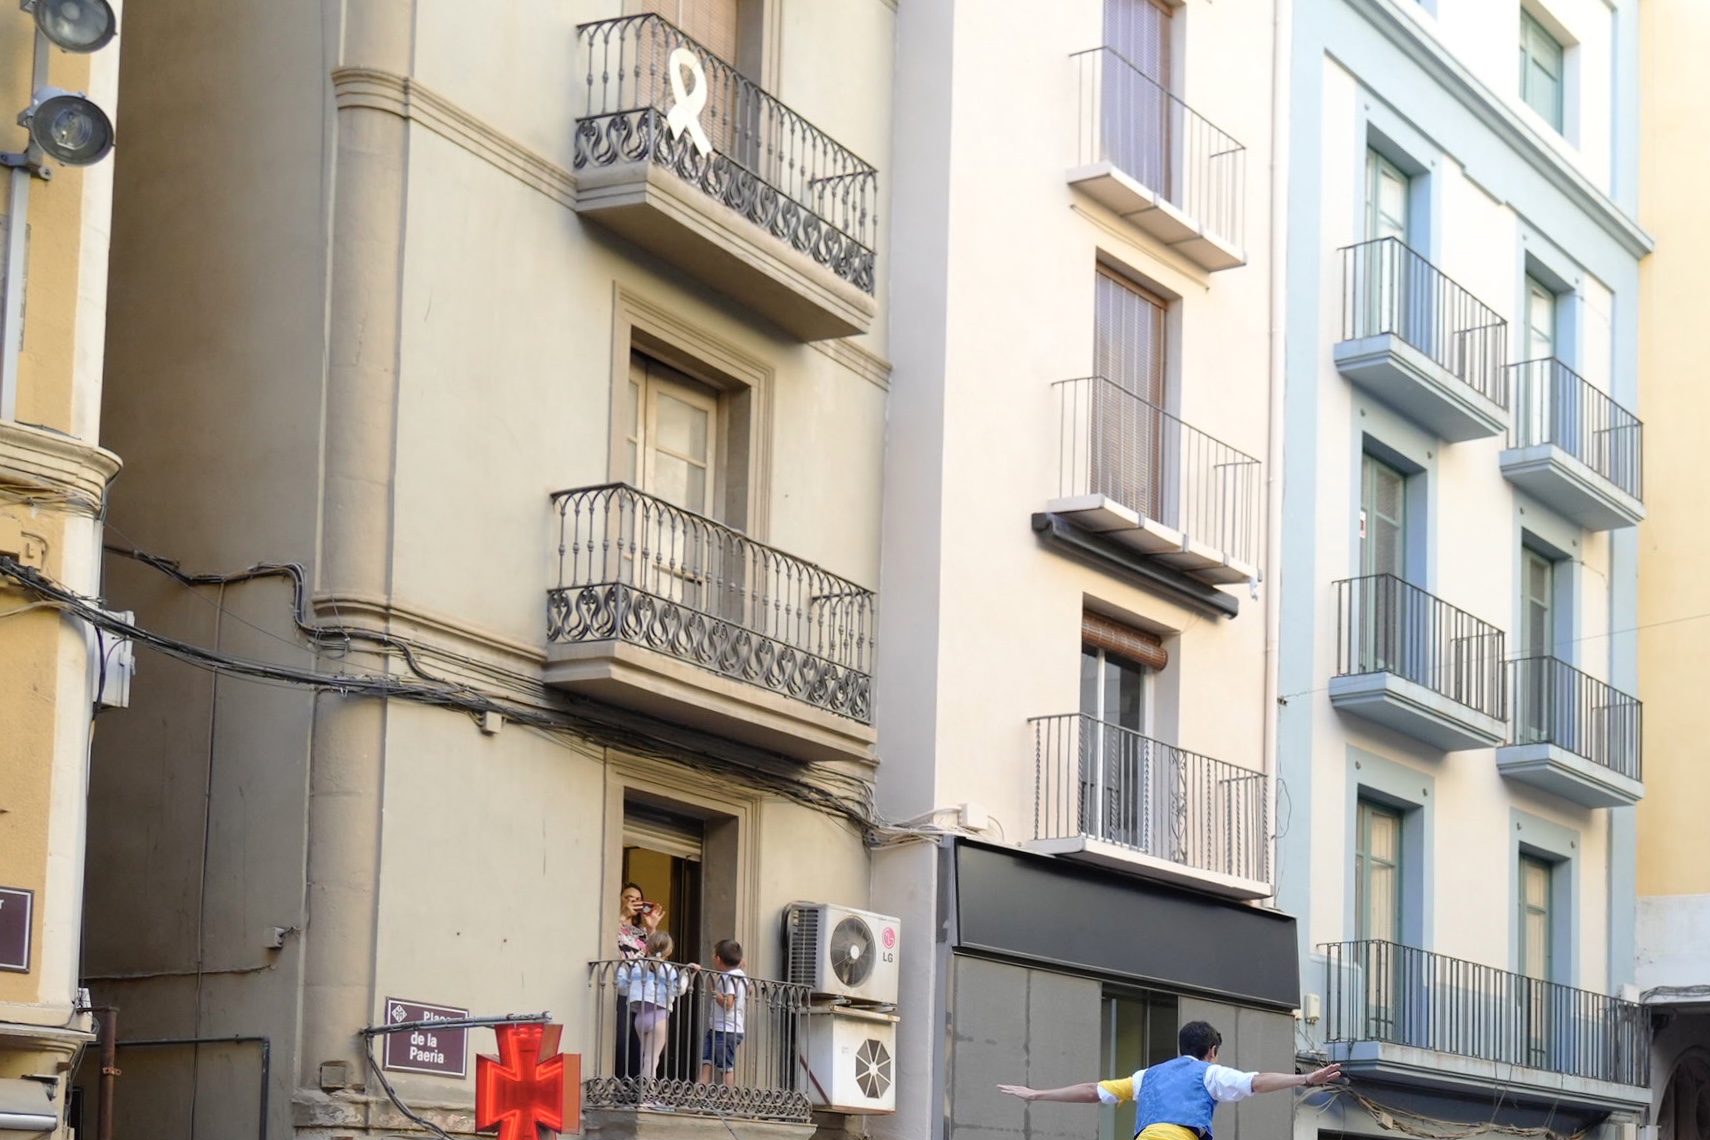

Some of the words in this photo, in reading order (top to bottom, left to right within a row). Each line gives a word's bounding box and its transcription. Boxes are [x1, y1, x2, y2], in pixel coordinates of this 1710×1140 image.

[882, 951, 893, 963] LG
[411, 1031, 425, 1046] de
[427, 1033, 437, 1048] la
[410, 1046, 444, 1063] Paeria
